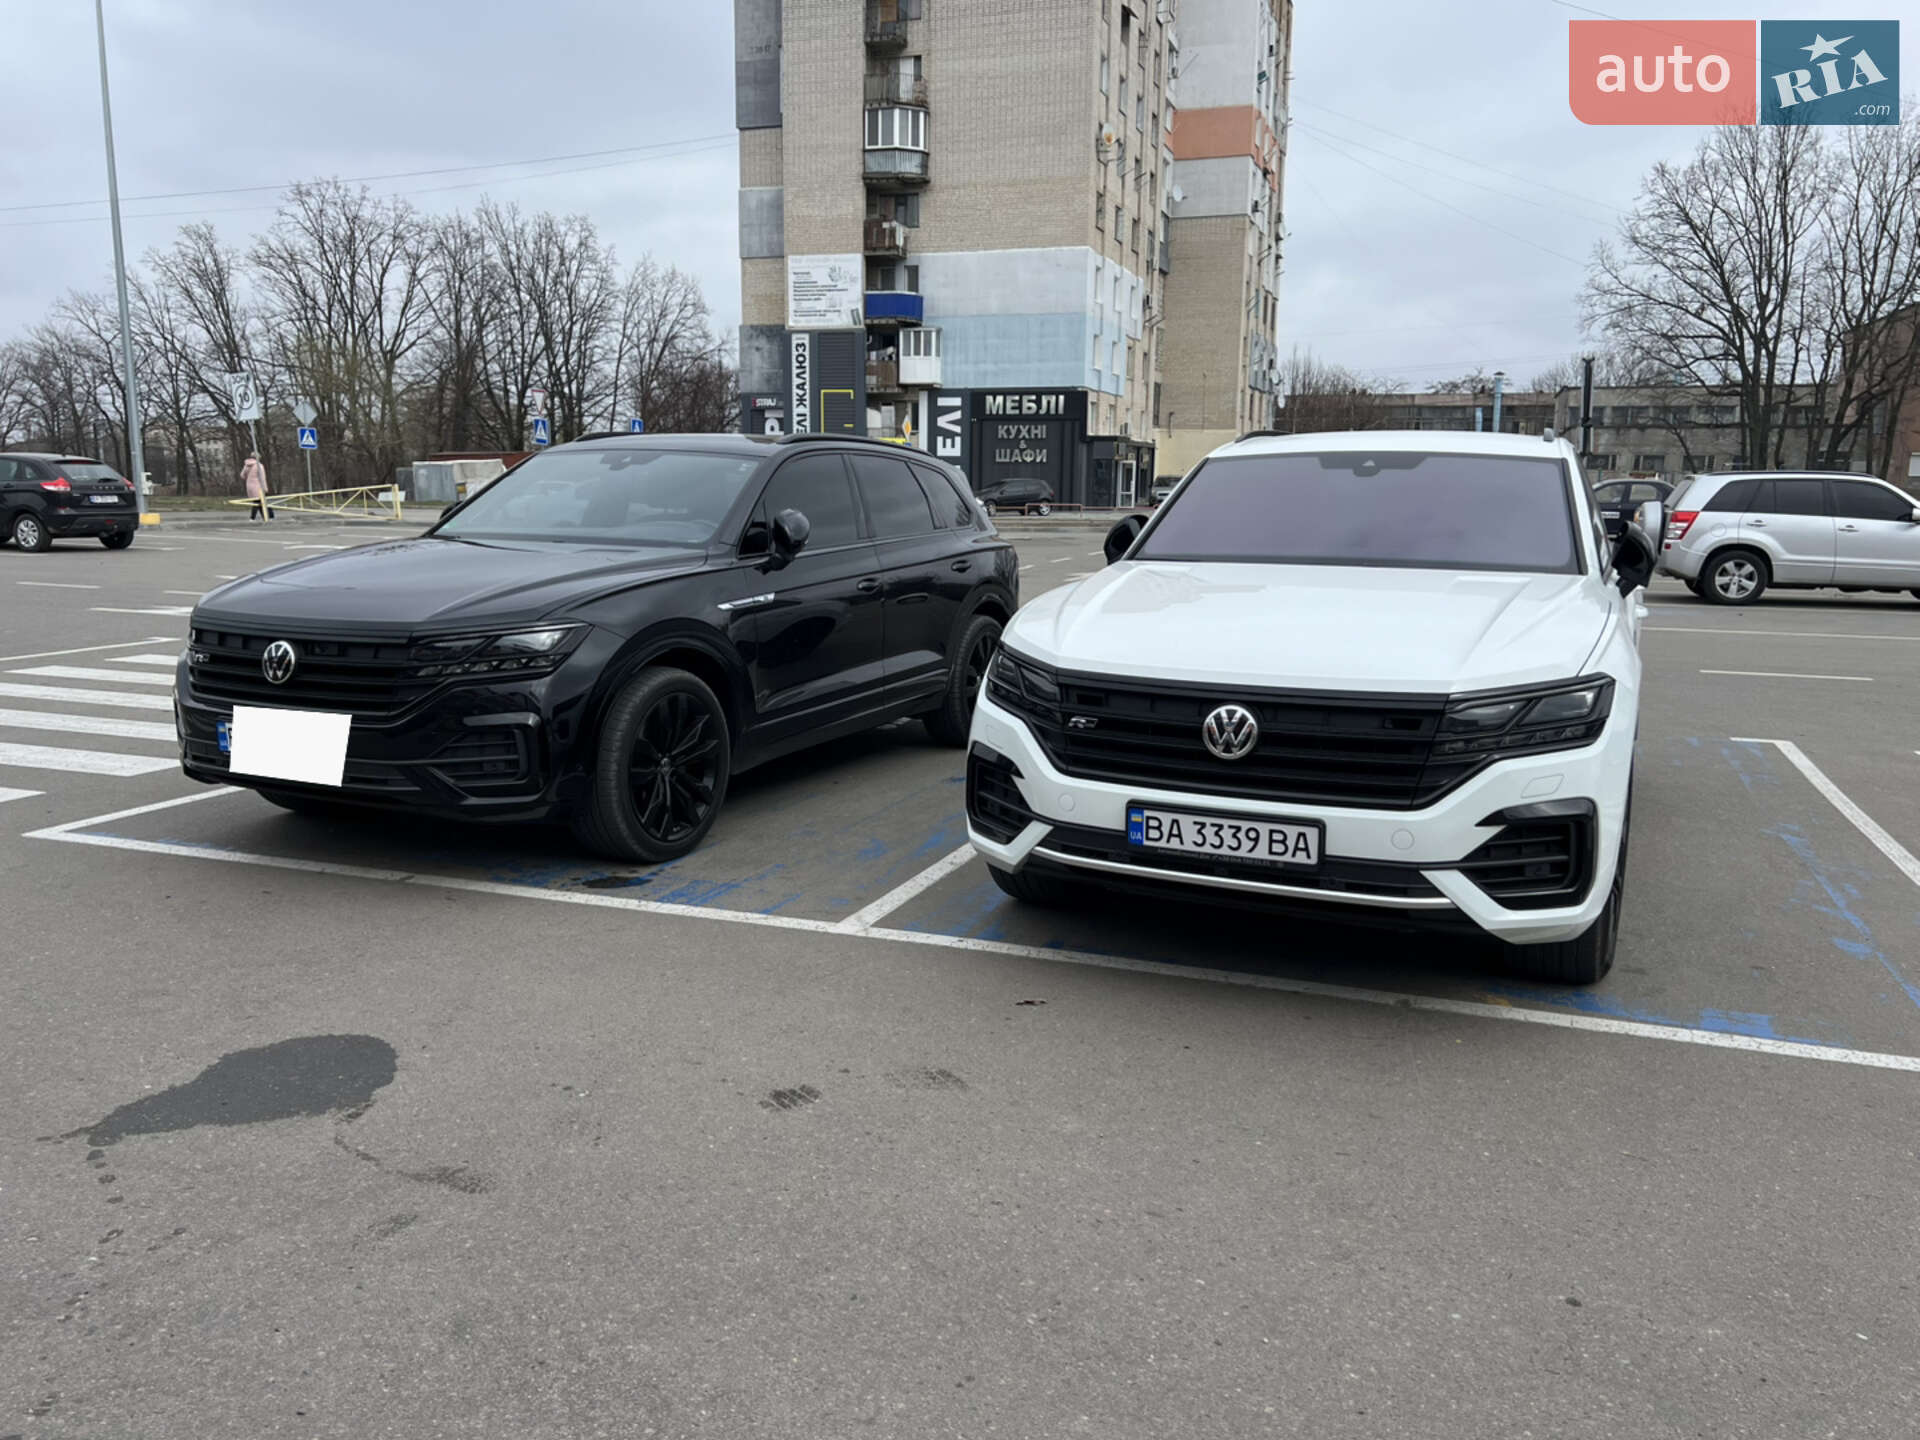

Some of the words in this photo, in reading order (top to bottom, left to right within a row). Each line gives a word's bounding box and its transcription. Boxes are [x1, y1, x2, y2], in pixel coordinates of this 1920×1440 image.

[985, 394, 1065, 415] МЕБЛІ
[937, 397, 962, 469] ЕЛІ
[998, 424, 1047, 439] КУХНІ
[995, 449, 1048, 463] ШАФИ
[1145, 815, 1184, 846] BA
[1192, 820, 1260, 854] 3339
[1268, 828, 1312, 860] BA
